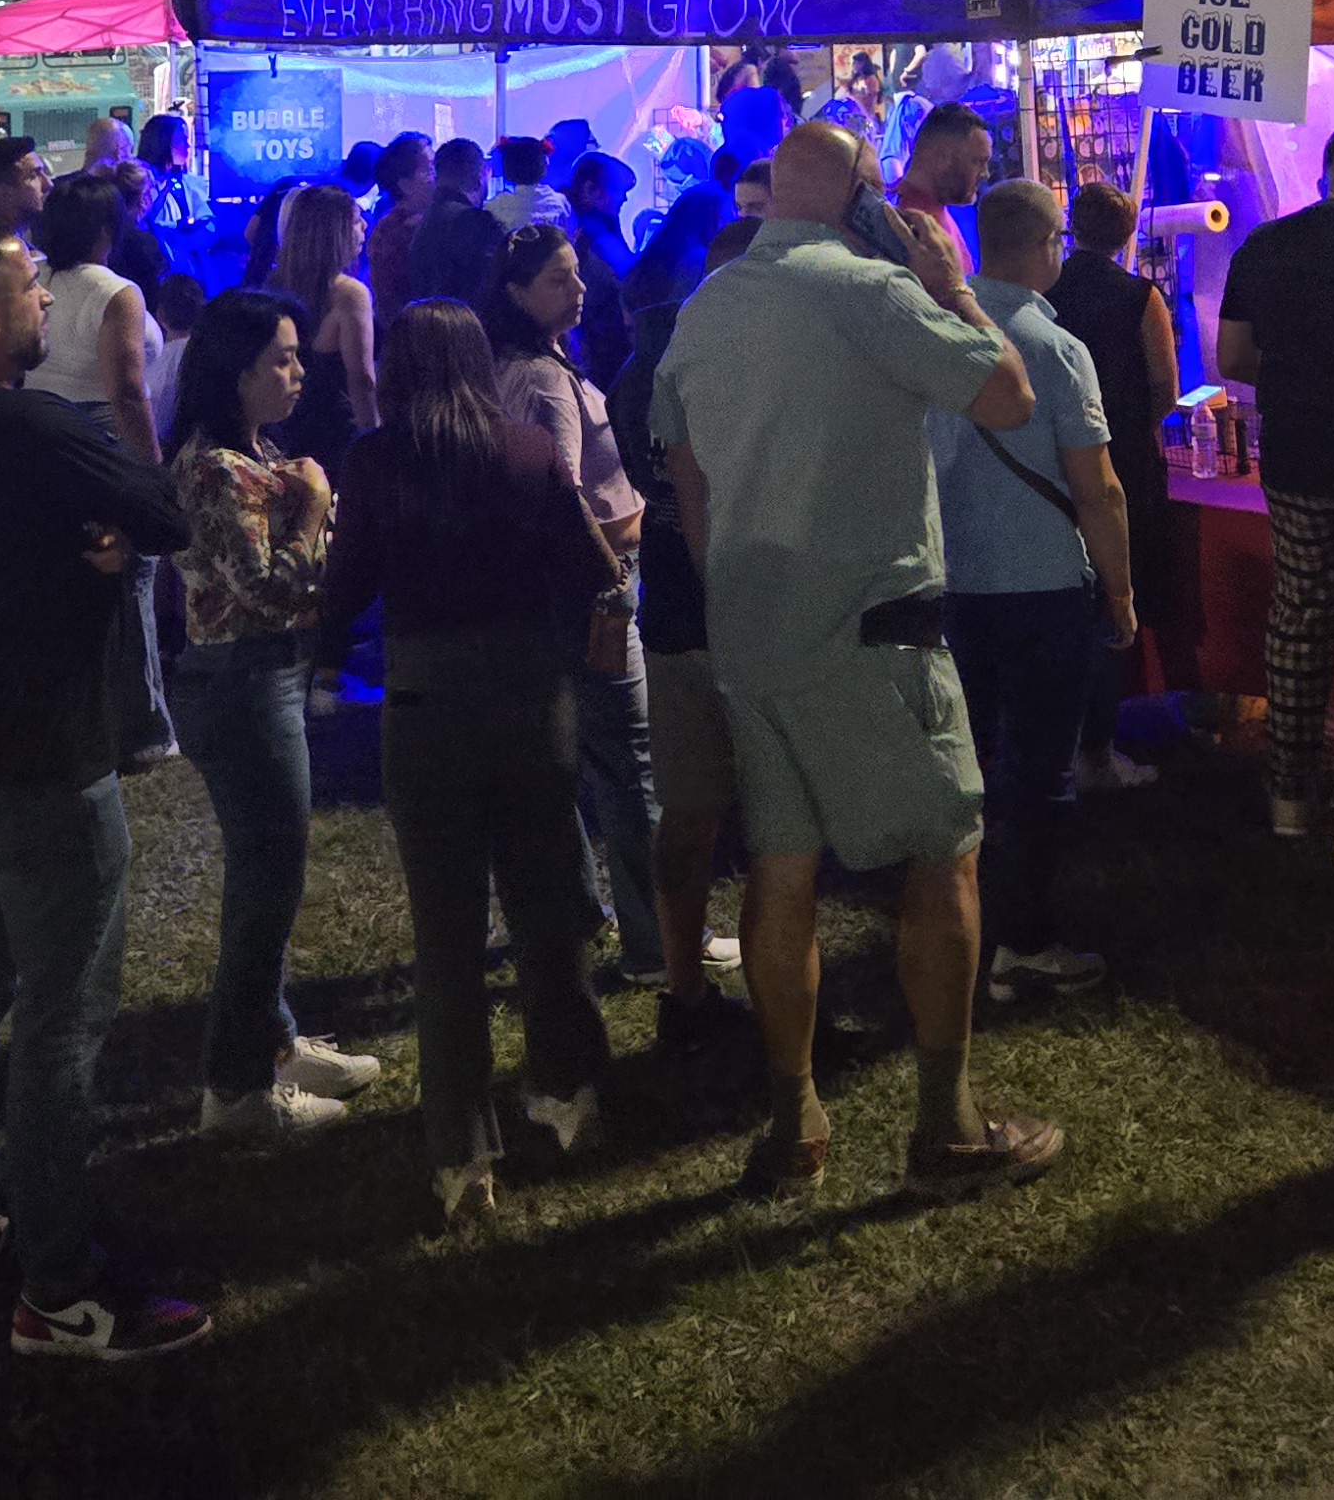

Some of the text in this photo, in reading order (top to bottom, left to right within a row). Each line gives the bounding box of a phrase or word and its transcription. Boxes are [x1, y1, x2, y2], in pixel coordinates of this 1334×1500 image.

[1180, 9, 1266, 56] COLD
[1176, 53, 1265, 103] BEER
[232, 106, 325, 131] BUBBLE
[251, 136, 315, 161] TOYS
